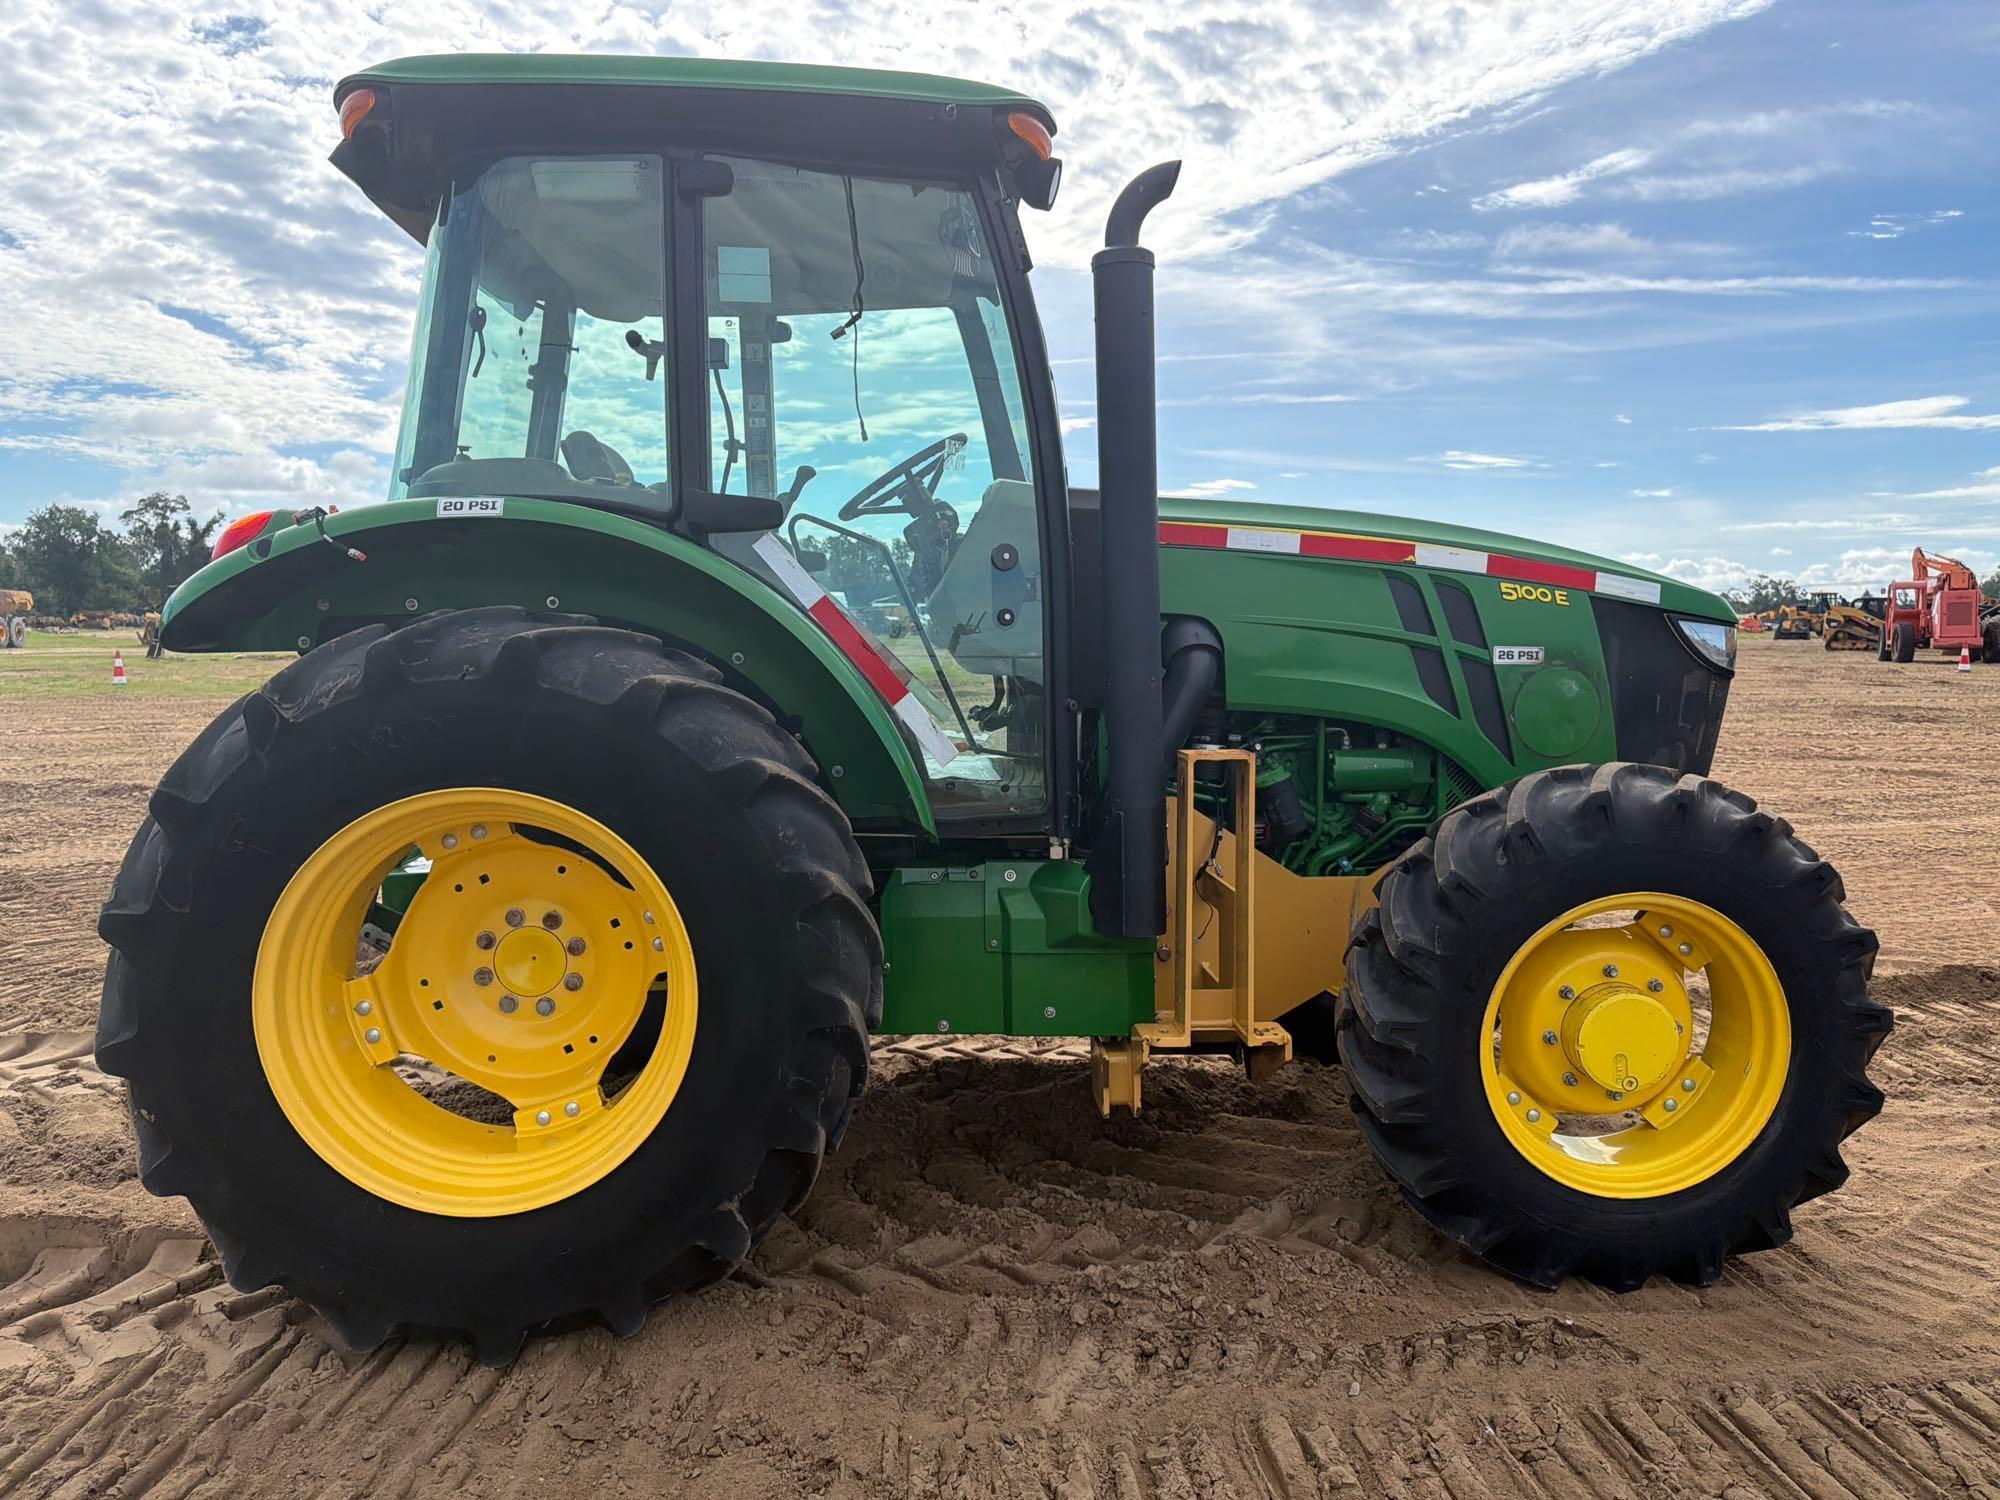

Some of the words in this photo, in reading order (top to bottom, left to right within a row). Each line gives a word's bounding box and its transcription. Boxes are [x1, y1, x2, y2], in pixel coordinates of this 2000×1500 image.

[442, 501, 464, 512] 20
[468, 500, 499, 511] PSI
[1499, 581, 1553, 603] 5100
[1553, 589, 1571, 607] E
[1497, 650, 1515, 660] 26
[1517, 650, 1541, 661] PSI
